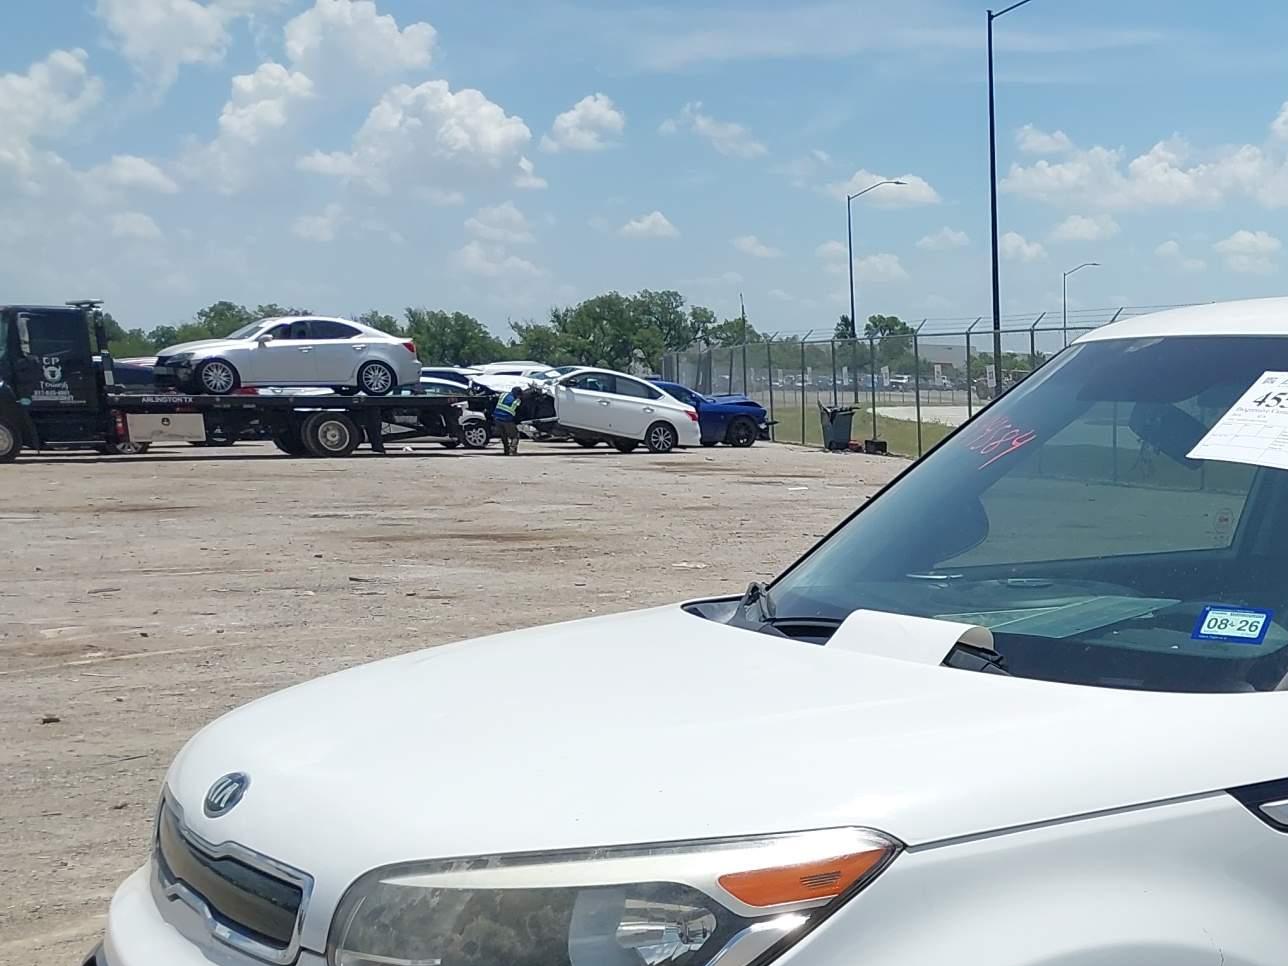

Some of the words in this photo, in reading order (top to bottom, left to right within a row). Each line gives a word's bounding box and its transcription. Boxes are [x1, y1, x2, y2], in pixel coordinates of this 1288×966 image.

[141, 396, 183, 404] ARLINGTON
[1206, 617, 1230, 630] 08
[1236, 619, 1260, 633] 26
